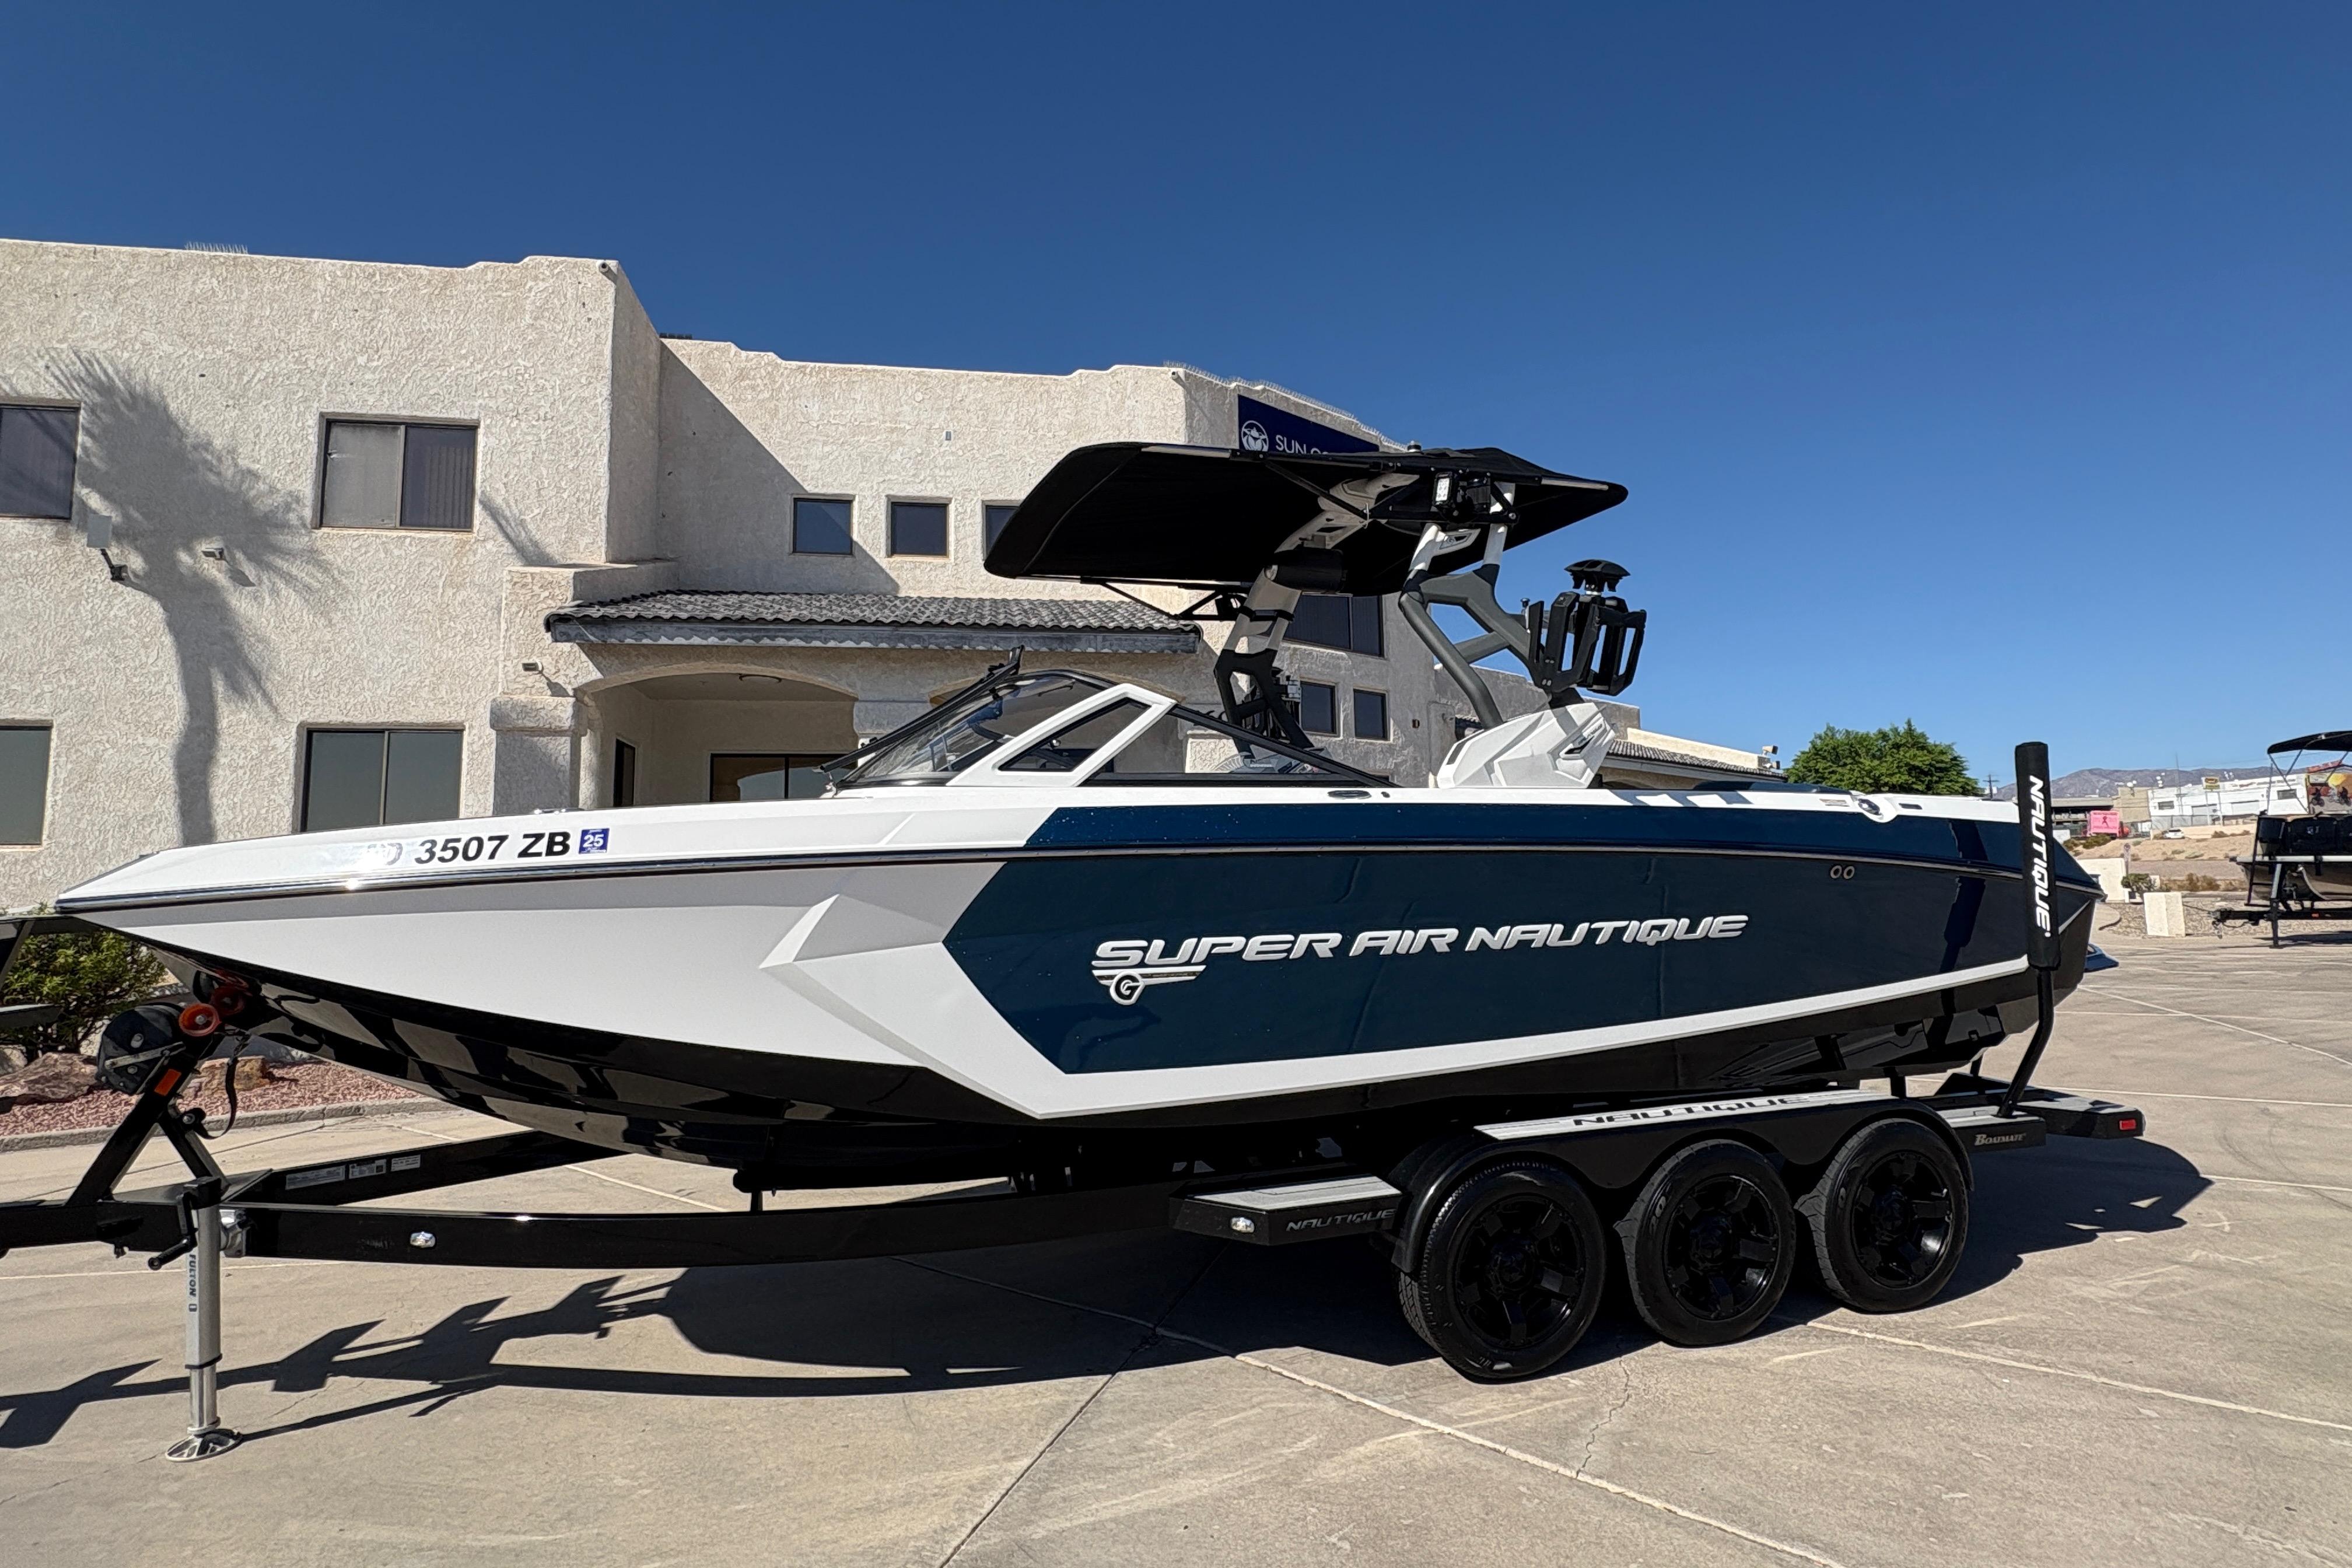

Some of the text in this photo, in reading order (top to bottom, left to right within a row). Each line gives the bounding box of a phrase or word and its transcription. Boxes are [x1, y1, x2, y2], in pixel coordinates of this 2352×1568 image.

[1275, 435, 1307, 454] SUN
[414, 834, 509, 864] 3507
[517, 831, 571, 858] ZB
[583, 834, 604, 848] 25
[2029, 775, 2050, 932] NAUTIQUE
[1091, 914, 1749, 967] SUPER AIR NAUTIQUE
[1573, 1098, 1810, 1126] NAUTIQUE
[1286, 1209, 1397, 1231] NAUTIQUE
